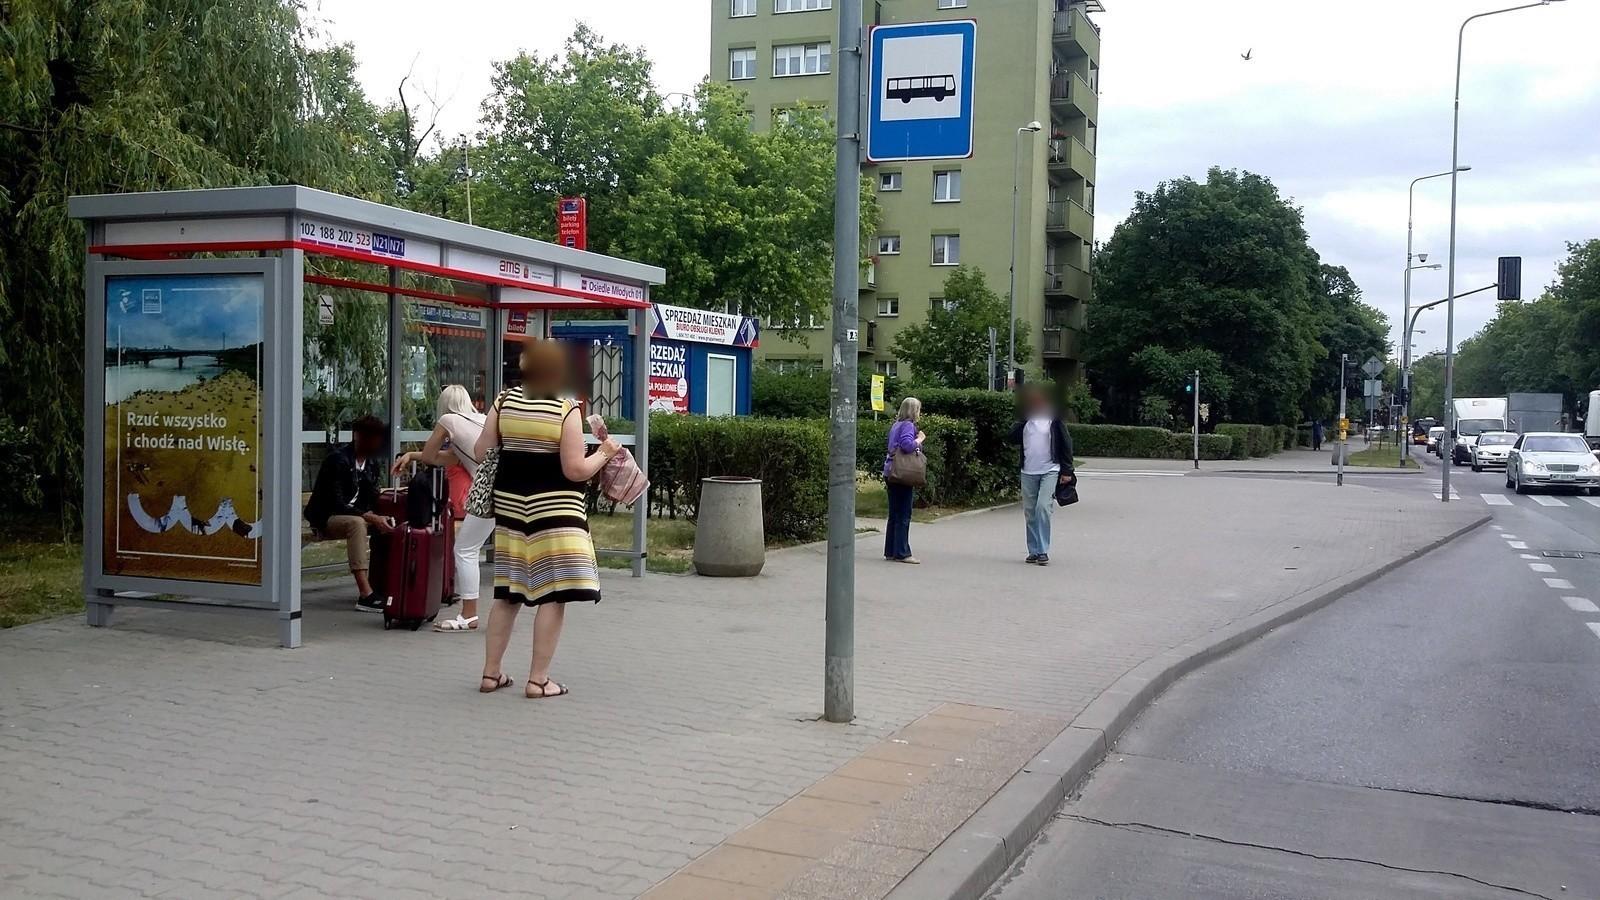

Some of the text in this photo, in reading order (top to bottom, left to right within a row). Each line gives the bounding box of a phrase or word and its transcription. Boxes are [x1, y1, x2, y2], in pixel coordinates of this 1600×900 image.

[301, 222, 404, 253] 102 188 202 523 N21 N71
[499, 260, 521, 275] ams
[589, 281, 642, 300] Osiedle Młodych 01
[665, 309, 737, 331] SPRZEDAŻ MIESZKAŃ
[676, 323, 726, 336] BIURO OBSŁUGI KLIENTA
[650, 344, 685, 362] RZEDAŻ
[127, 411, 227, 431] Rzuć wszystko
[126, 432, 250, 456] i chodź nad Wisłę.
